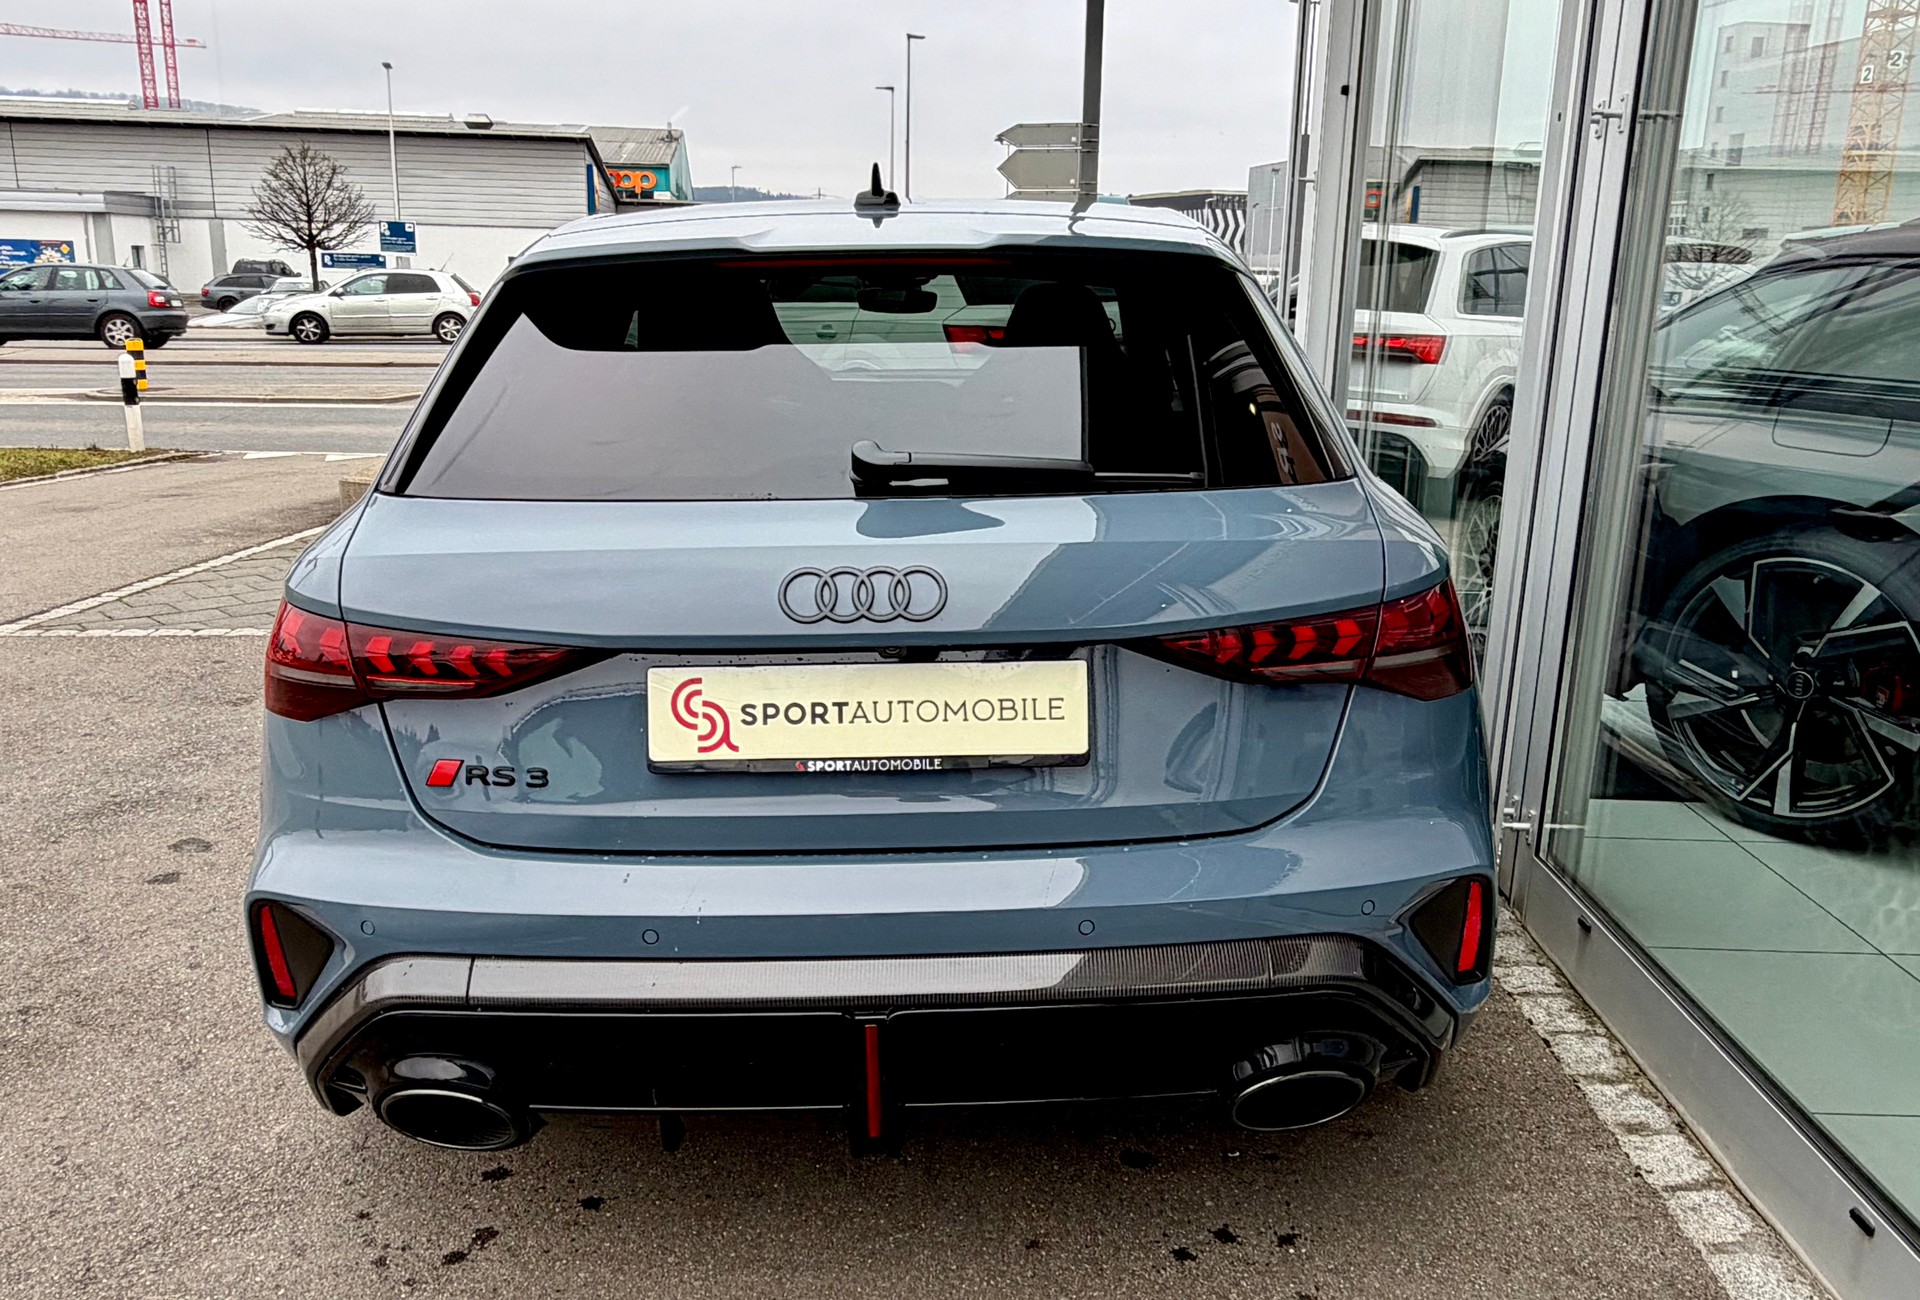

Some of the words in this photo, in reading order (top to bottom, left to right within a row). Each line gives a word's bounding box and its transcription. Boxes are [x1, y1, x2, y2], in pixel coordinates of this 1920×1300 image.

[1889, 52, 1902, 67] 2
[1862, 67, 1872, 82] 2
[605, 170, 657, 194] oop
[740, 697, 1065, 726] SPORTAUTOMOBILE
[807, 758, 942, 772] SPORTAUTOMOBILE
[465, 765, 516, 787] RS
[525, 767, 549, 789] 3
